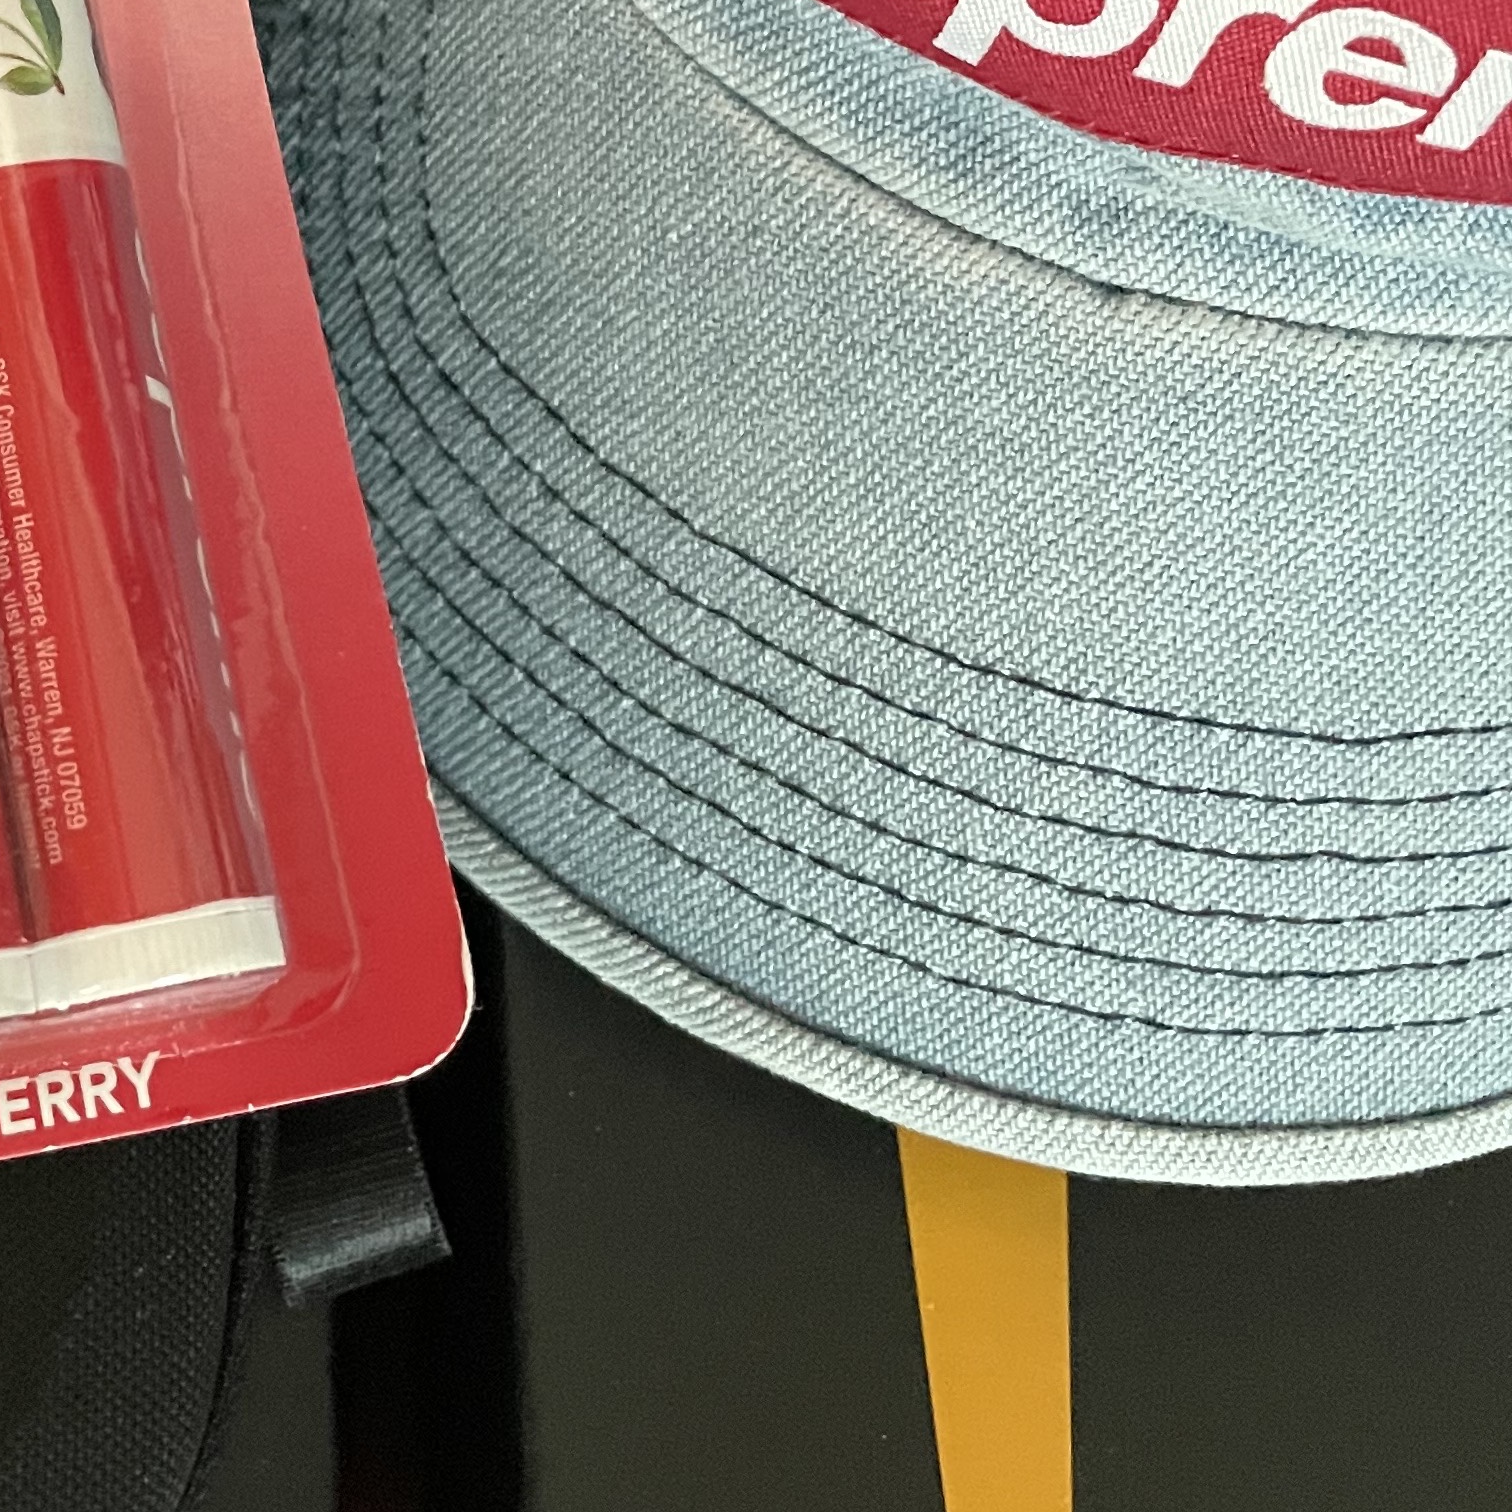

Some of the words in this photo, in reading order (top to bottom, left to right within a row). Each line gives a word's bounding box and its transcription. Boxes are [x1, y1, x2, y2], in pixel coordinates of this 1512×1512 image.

[3, 590, 26, 637] visit
[13, 513, 48, 635] Healthcare,
[35, 636, 63, 724] Warren,
[11, 640, 63, 865] www.chapstick.com
[51, 726, 75, 757] NJ
[57, 761, 88, 831] 07059
